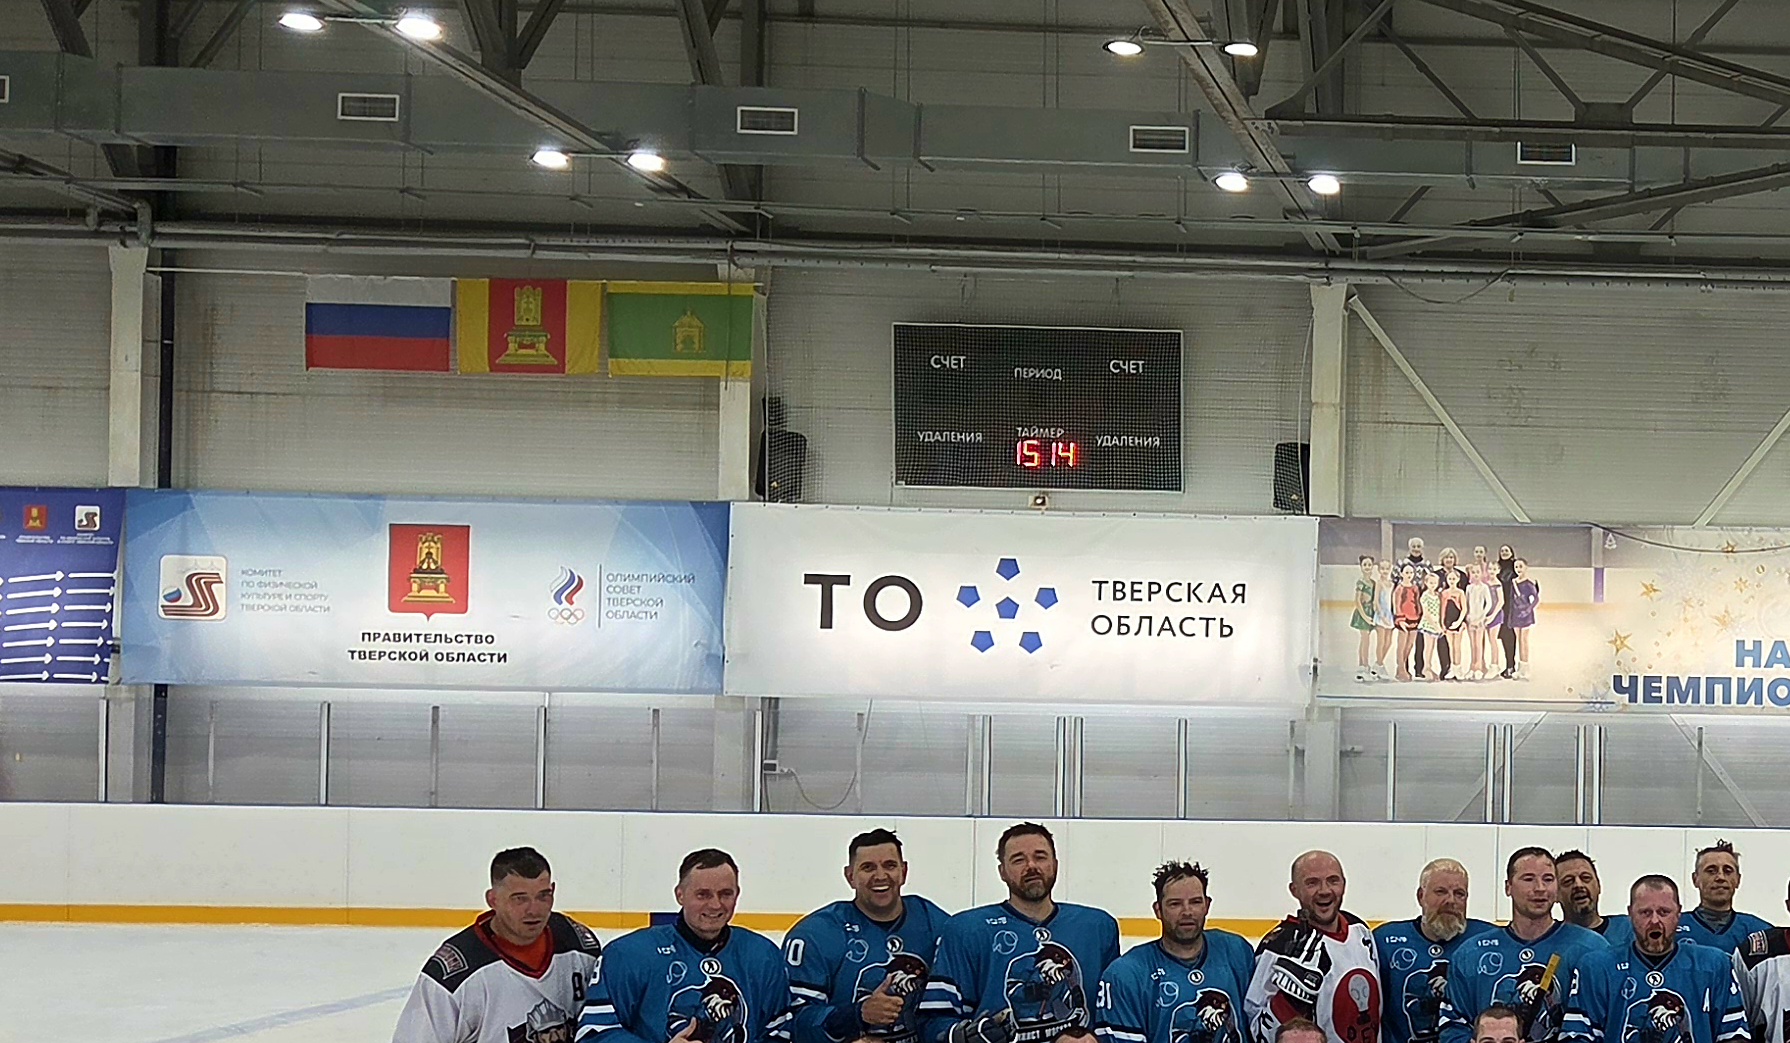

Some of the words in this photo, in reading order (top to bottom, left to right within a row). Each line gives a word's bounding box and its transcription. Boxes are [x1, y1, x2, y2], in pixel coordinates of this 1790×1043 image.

[930, 355, 966, 369] СЧЕТ
[1109, 360, 1144, 374] СЧЕТ
[1014, 367, 1062, 381] ПЕРИОД
[917, 431, 982, 443] УДАЛЕНИЯ
[1016, 426, 1064, 438] ТАЙМЕР
[1096, 435, 1160, 448] УДАЛЕНИЯ
[241, 569, 282, 577] КОМИТЕТ
[606, 572, 695, 584] ОЛИМПИЙСКИЙ
[606, 585, 642, 595] СОВЕТ
[1092, 579, 1247, 605] ТВЕРСКАЯ
[606, 597, 664, 608] ТВЕРСКОЙ
[804, 574, 923, 632] ТО
[606, 609, 658, 620] ОБЛАСТИ
[1090, 614, 1234, 639] ОБЛАСТЬ
[361, 632, 495, 645] ПРАВИТЕЛЬСТВО
[347, 649, 430, 662] ТВЕРСКОЙ
[434, 652, 508, 664] ОБЛАСТИ
